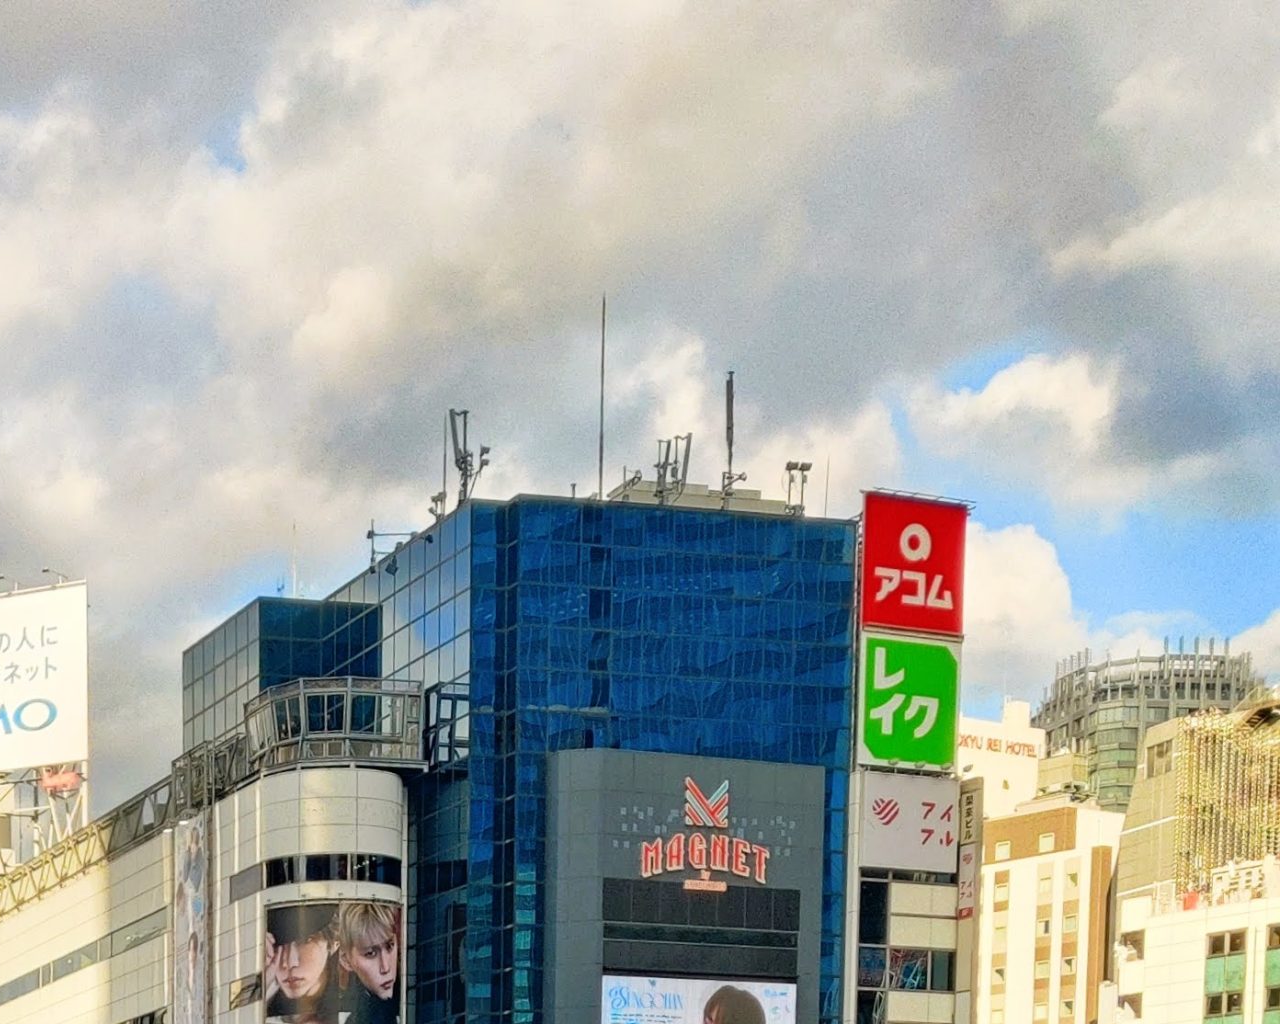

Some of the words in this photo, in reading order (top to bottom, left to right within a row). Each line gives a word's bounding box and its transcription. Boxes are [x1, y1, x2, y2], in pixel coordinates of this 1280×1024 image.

[874, 567, 954, 610] アコム
[1005, 740, 1037, 758] HOTEL
[641, 832, 770, 885] MAGNET
